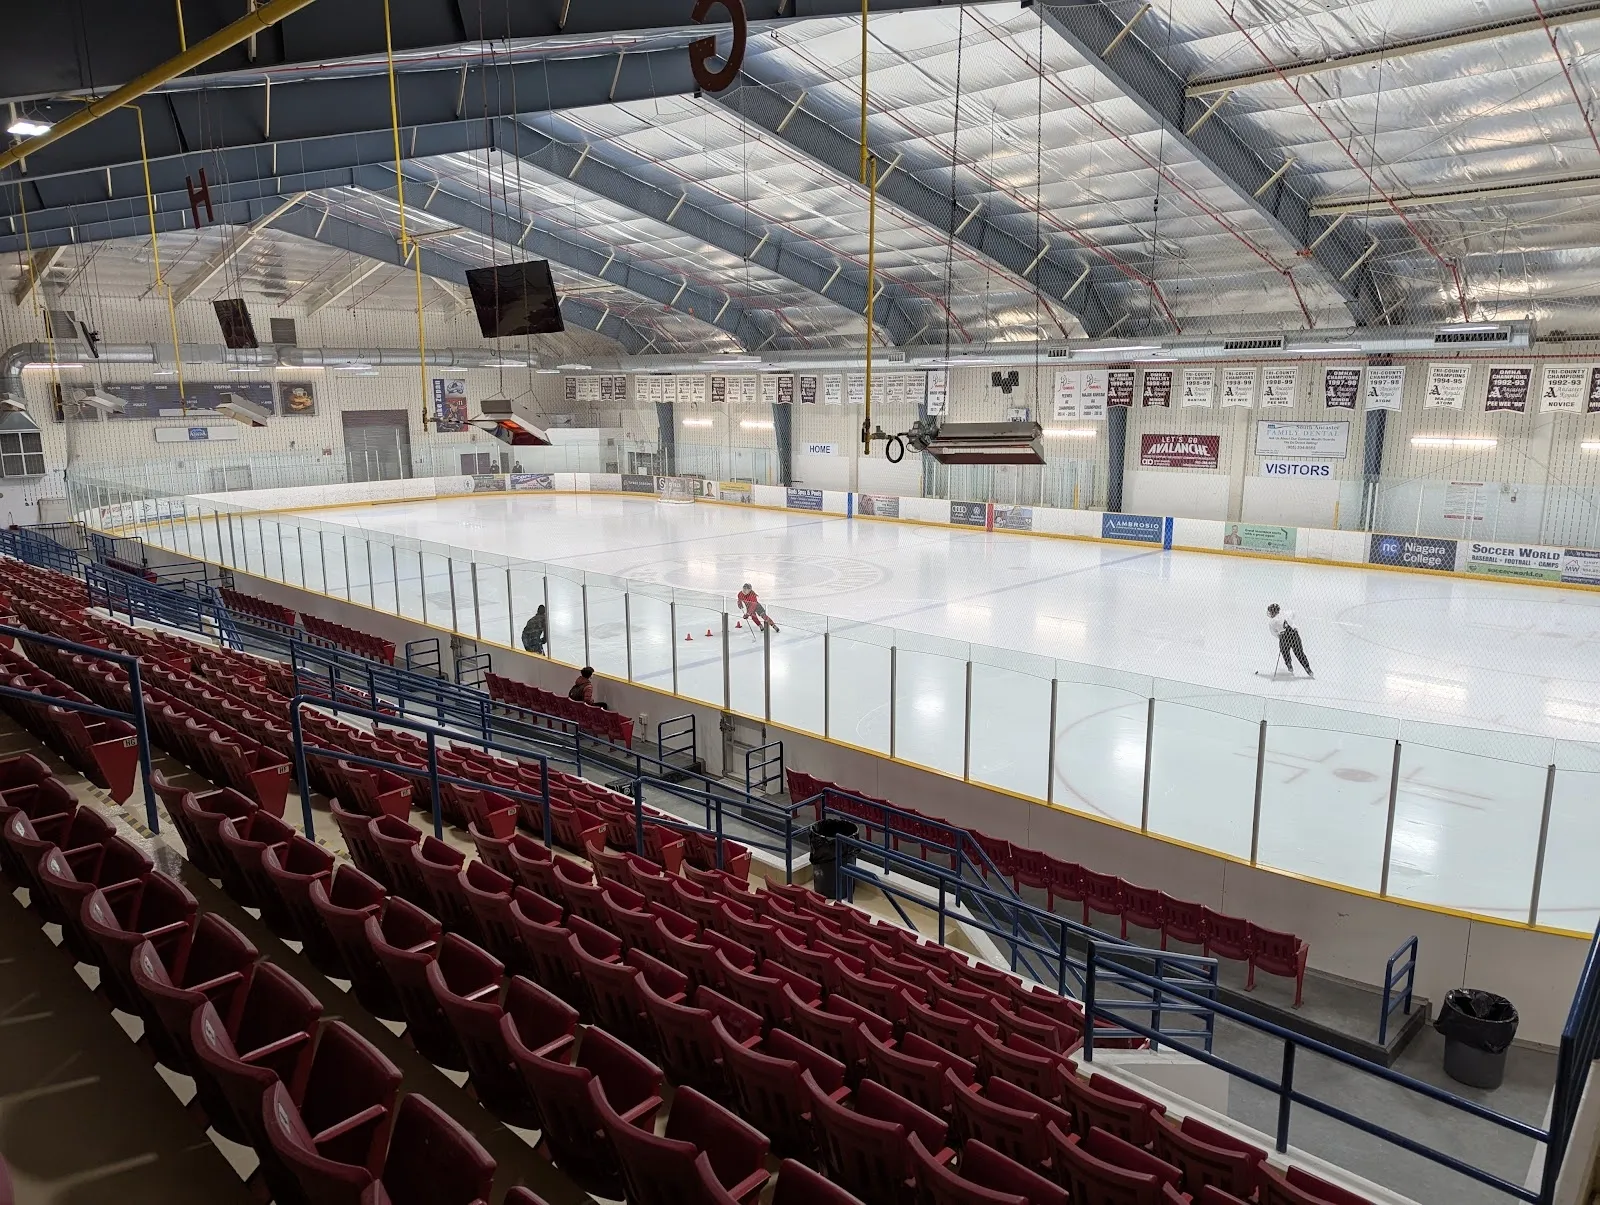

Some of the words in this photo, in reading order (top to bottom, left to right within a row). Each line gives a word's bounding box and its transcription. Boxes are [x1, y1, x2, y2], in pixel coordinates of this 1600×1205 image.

[185, 168, 214, 229] H
[1185, 387, 1193, 396] A
[1225, 387, 1234, 396] A
[1264, 386, 1274, 396] A
[1327, 386, 1336, 396] A
[1368, 387, 1379, 396] A
[1429, 385, 1441, 395] A
[1489, 387, 1502, 397] A
[1544, 387, 1557, 398] A
[1148, 443, 1210, 456] AVALANCHE
[1266, 464, 1330, 476] VISITORS
[1383, 544, 1397, 552] nc
[1404, 542, 1446, 555] Niagara
[1472, 544, 1514, 557] SOCCER
[1519, 548, 1560, 561] WORLD
[1404, 553, 1441, 565] College
[1488, 568, 1543, 578] soccer-world.ca
